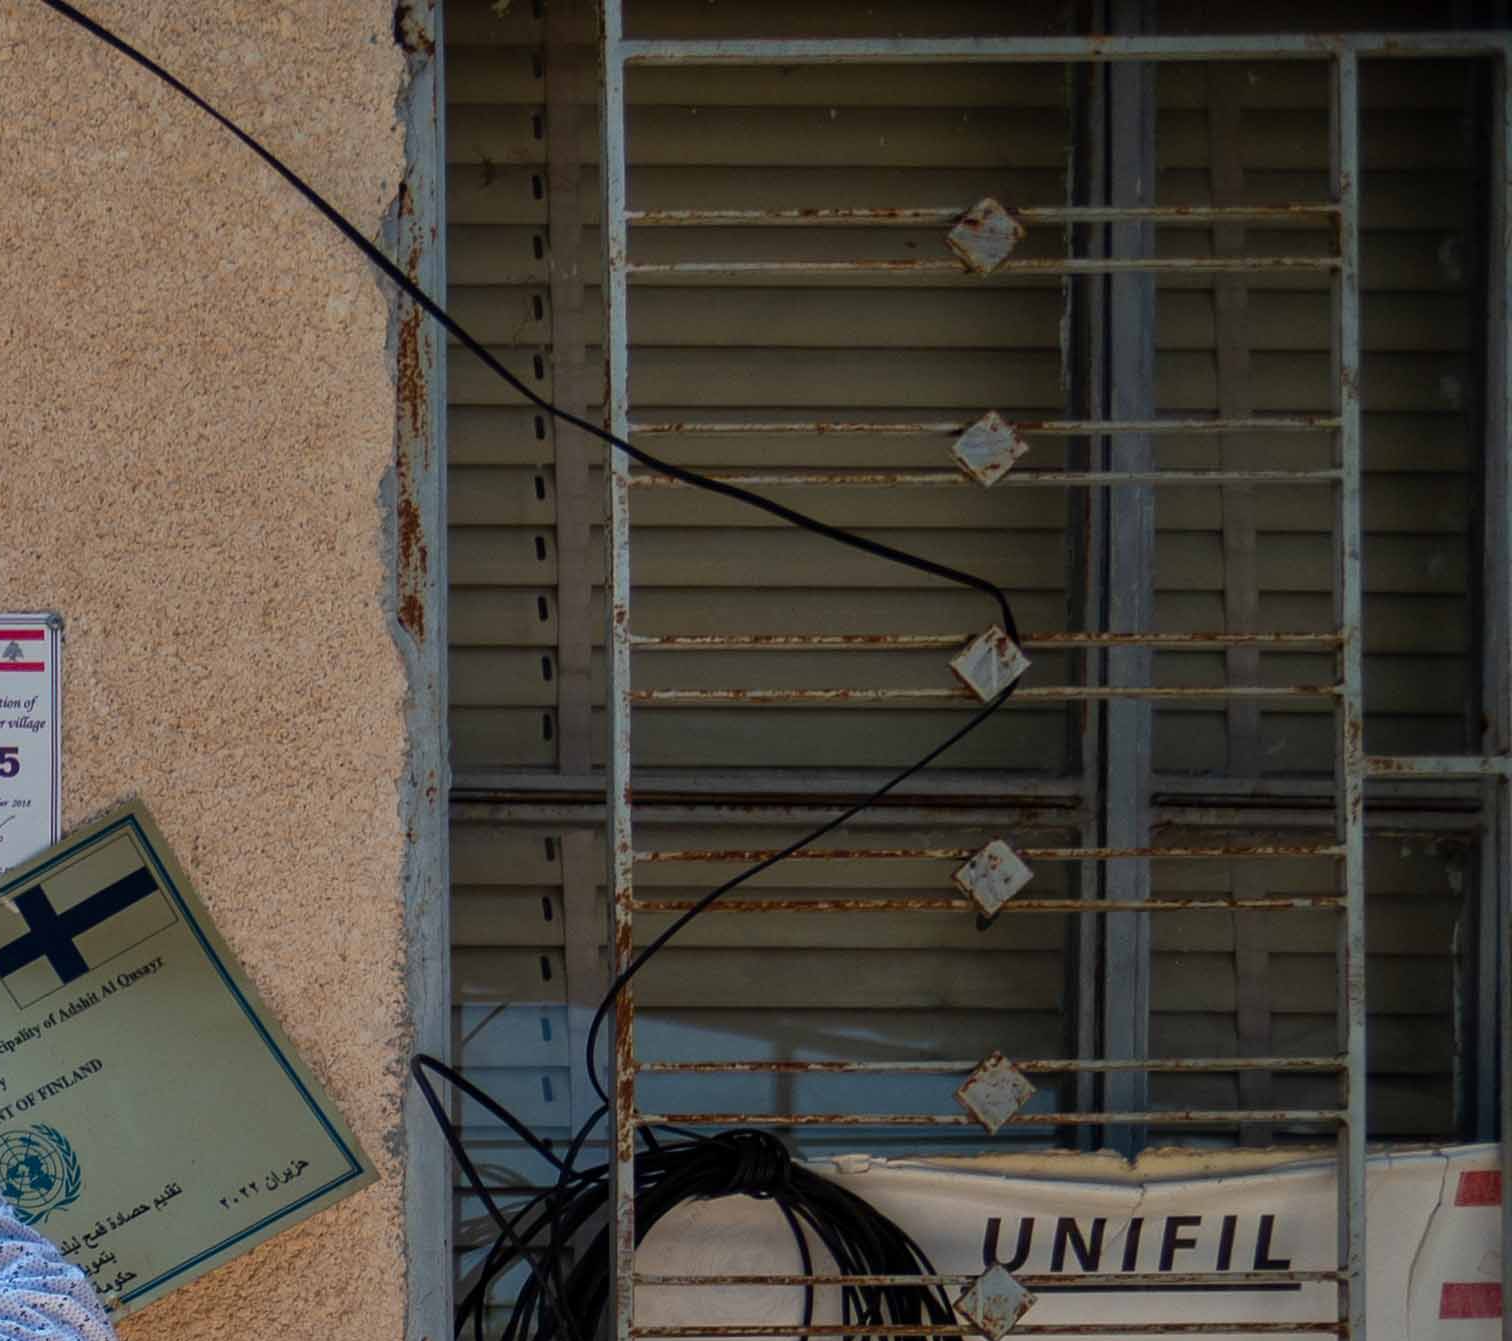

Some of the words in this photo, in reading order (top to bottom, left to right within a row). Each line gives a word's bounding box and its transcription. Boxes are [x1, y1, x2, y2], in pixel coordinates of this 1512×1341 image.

[8, 715, 46, 733] village
[24, 696, 38, 713] of
[42, 1014, 58, 1029] of
[58, 992, 99, 1021] Adshit
[101, 985, 117, 998] Al
[117, 956, 165, 986] Qusayr
[15, 1094, 36, 1111] OF
[38, 1058, 104, 1102] FINLAND
[983, 1215, 1290, 1272] UNIFIL
